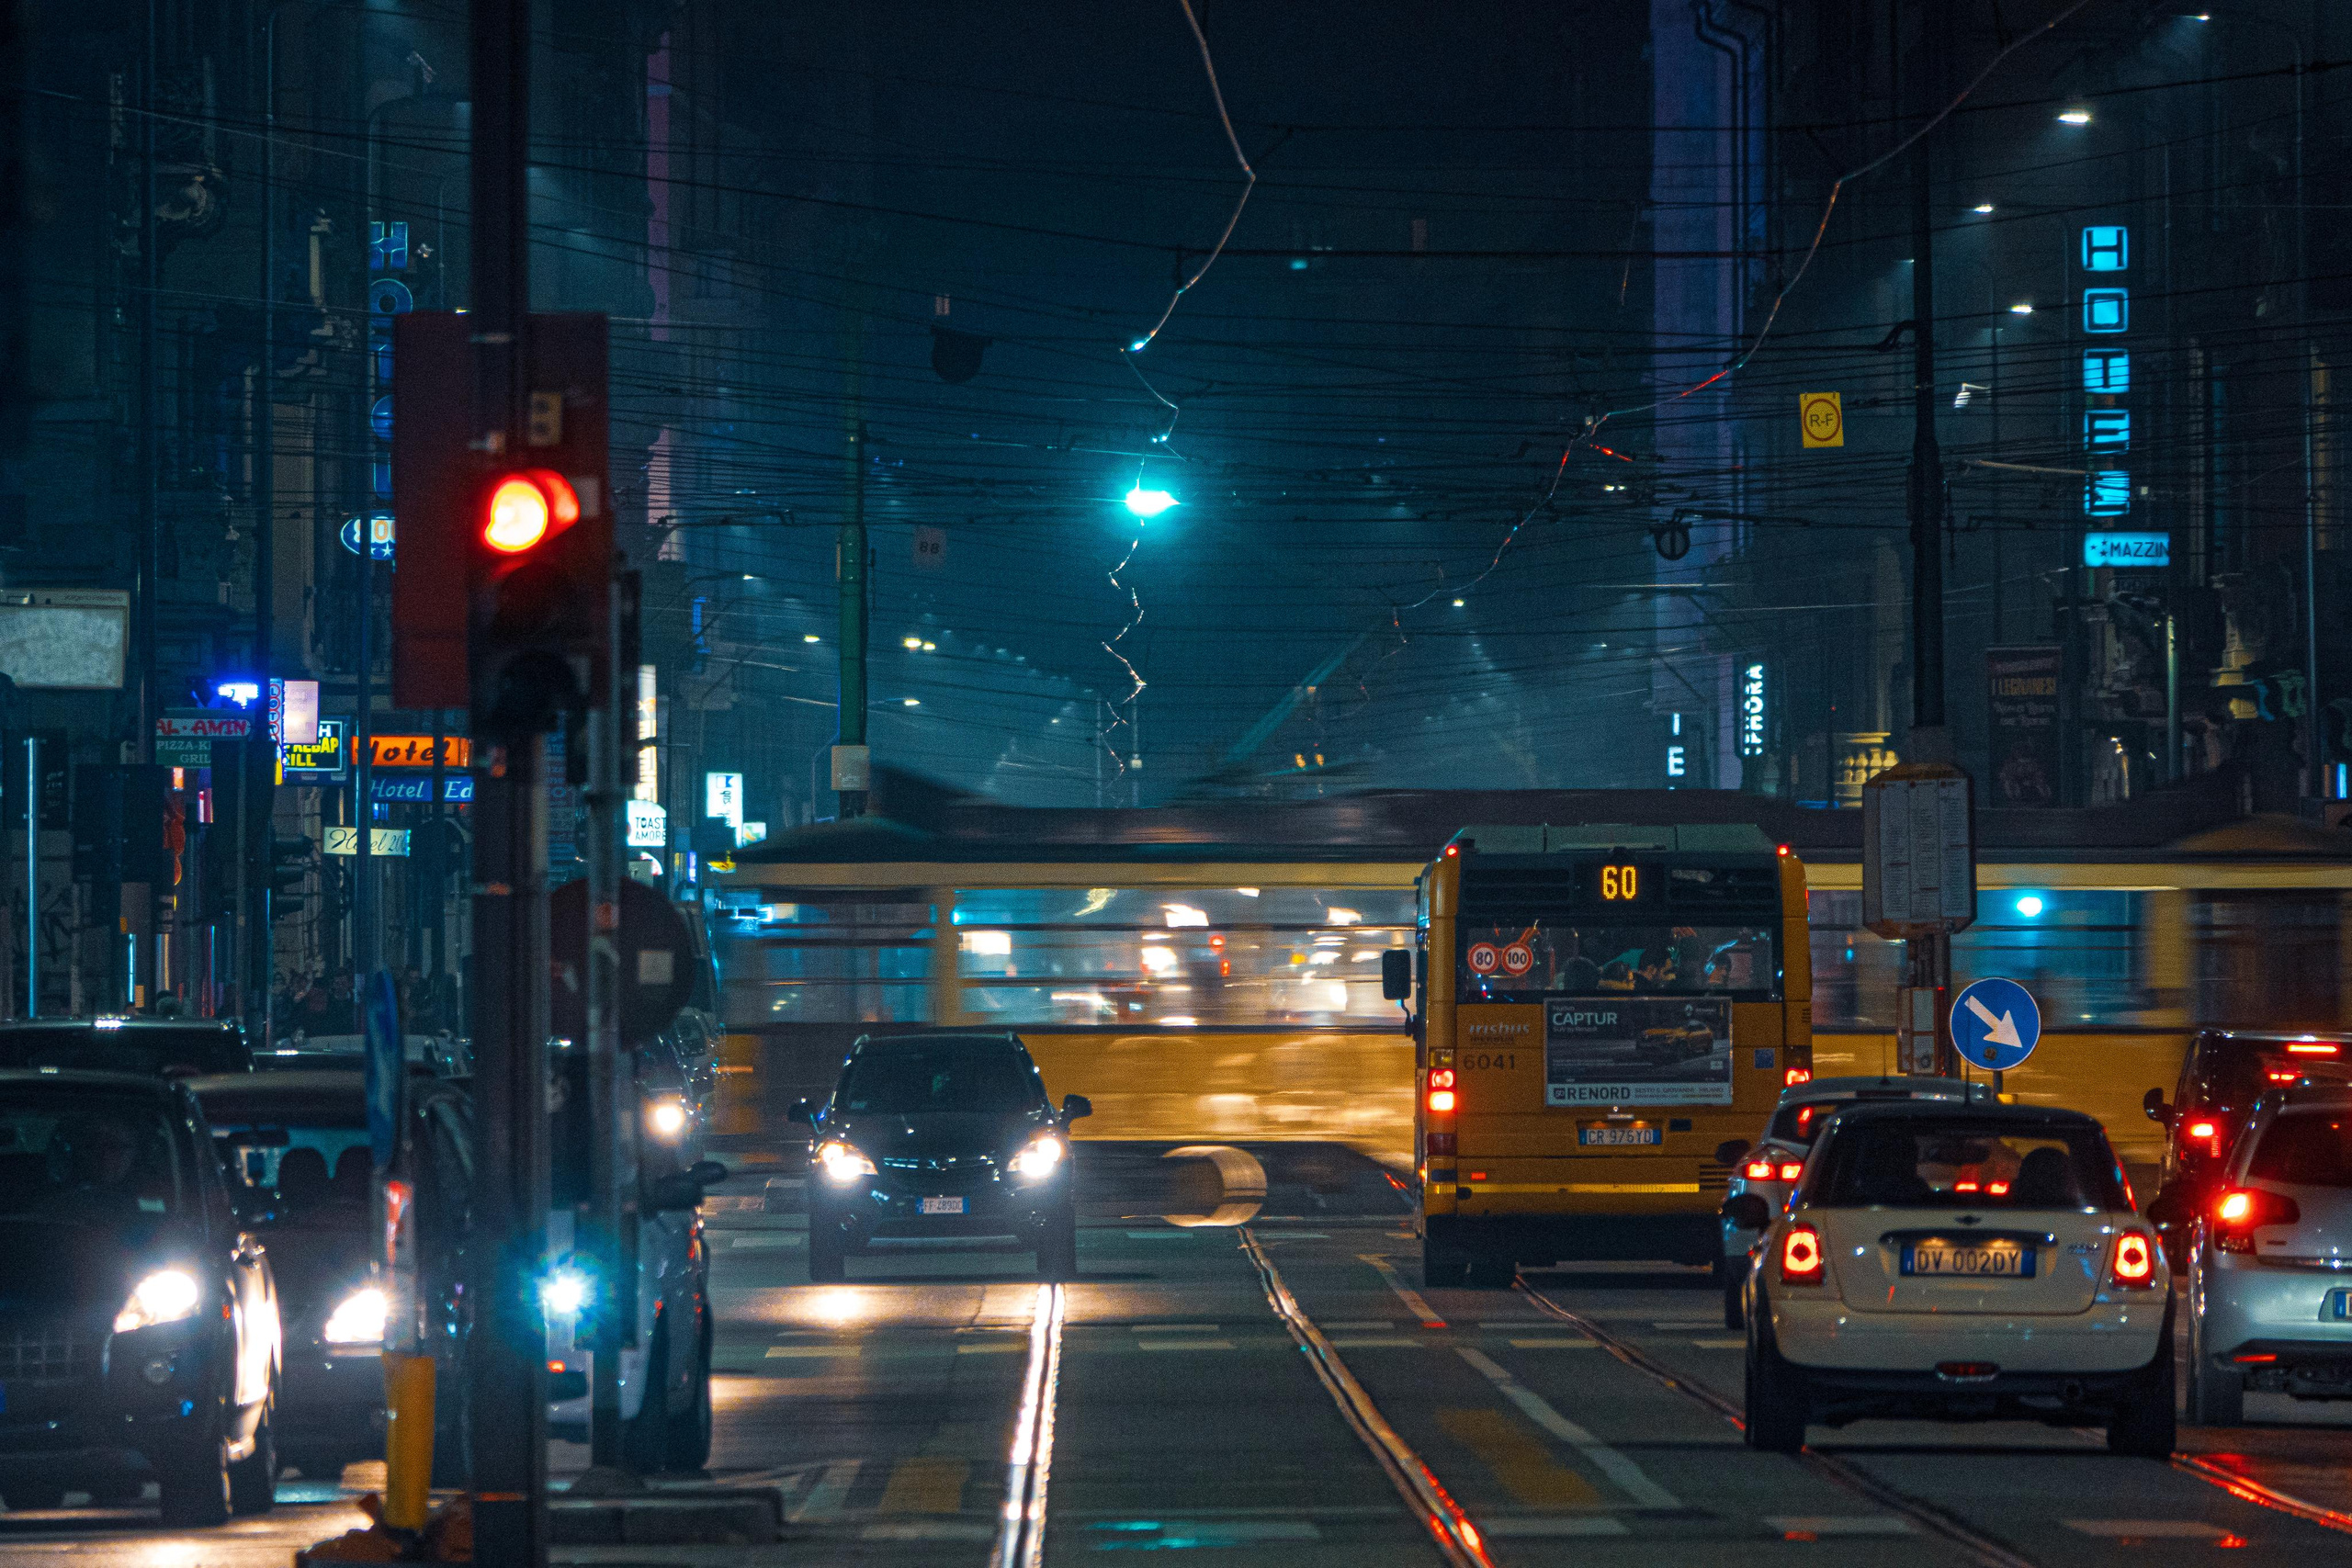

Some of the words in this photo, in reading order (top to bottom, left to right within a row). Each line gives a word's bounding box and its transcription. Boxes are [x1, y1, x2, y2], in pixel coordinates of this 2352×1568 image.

[2085, 229, 2127, 512] HOTEL
[1809, 412, 1834, 427] R-F
[371, 779, 424, 798] Hotel
[1601, 865, 1637, 900] 60
[1476, 952, 1494, 965] 80
[1507, 951, 1528, 964] 100
[1553, 1012, 1617, 1025] CAPTUR
[1464, 1054, 1515, 1070] 6041
[1567, 1087, 1631, 1100] RENORD
[1589, 1130, 1604, 1144] CR
[1917, 1250, 1943, 1272] DV
[1952, 1249, 2019, 1273] 002DY
